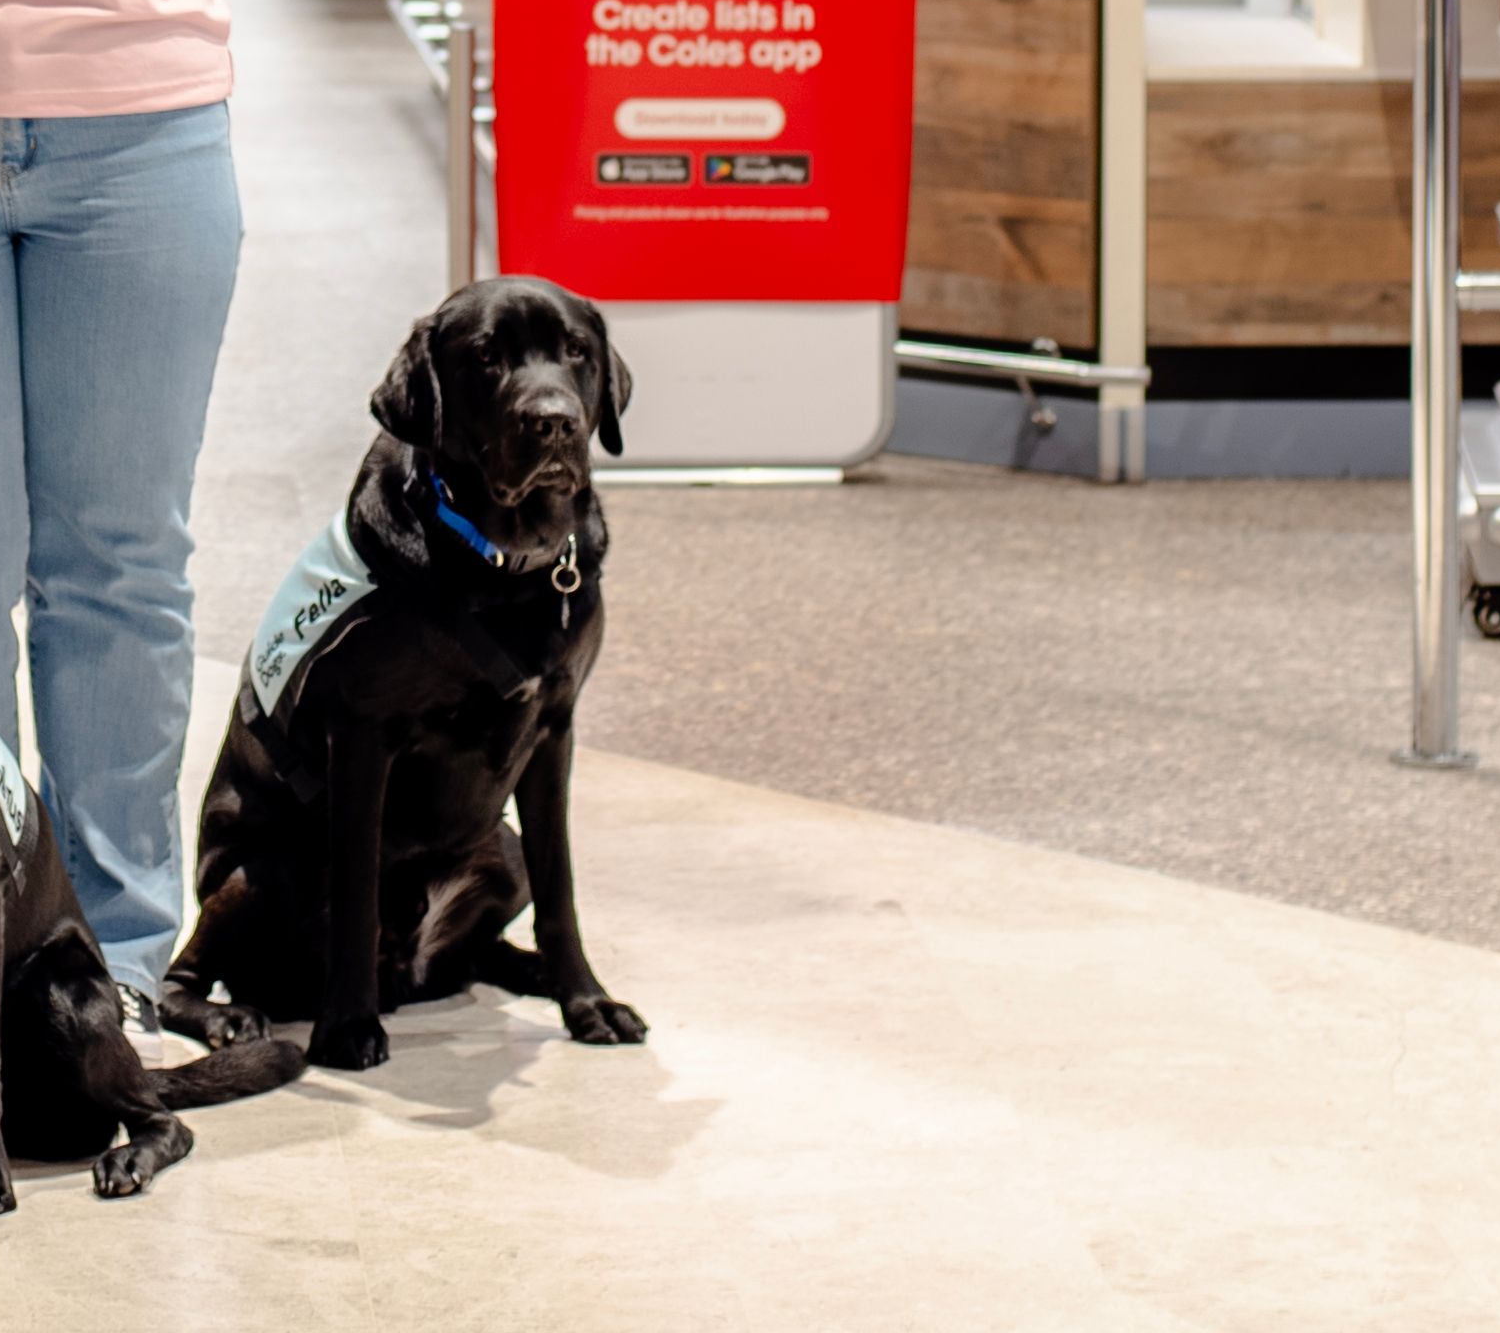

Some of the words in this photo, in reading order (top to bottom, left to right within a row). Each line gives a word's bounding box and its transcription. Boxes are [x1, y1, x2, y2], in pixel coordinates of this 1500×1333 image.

[586, 34, 642, 67] the
[648, 35, 744, 67] Coles
[749, 39, 822, 73] app
[294, 579, 347, 641] Fella
